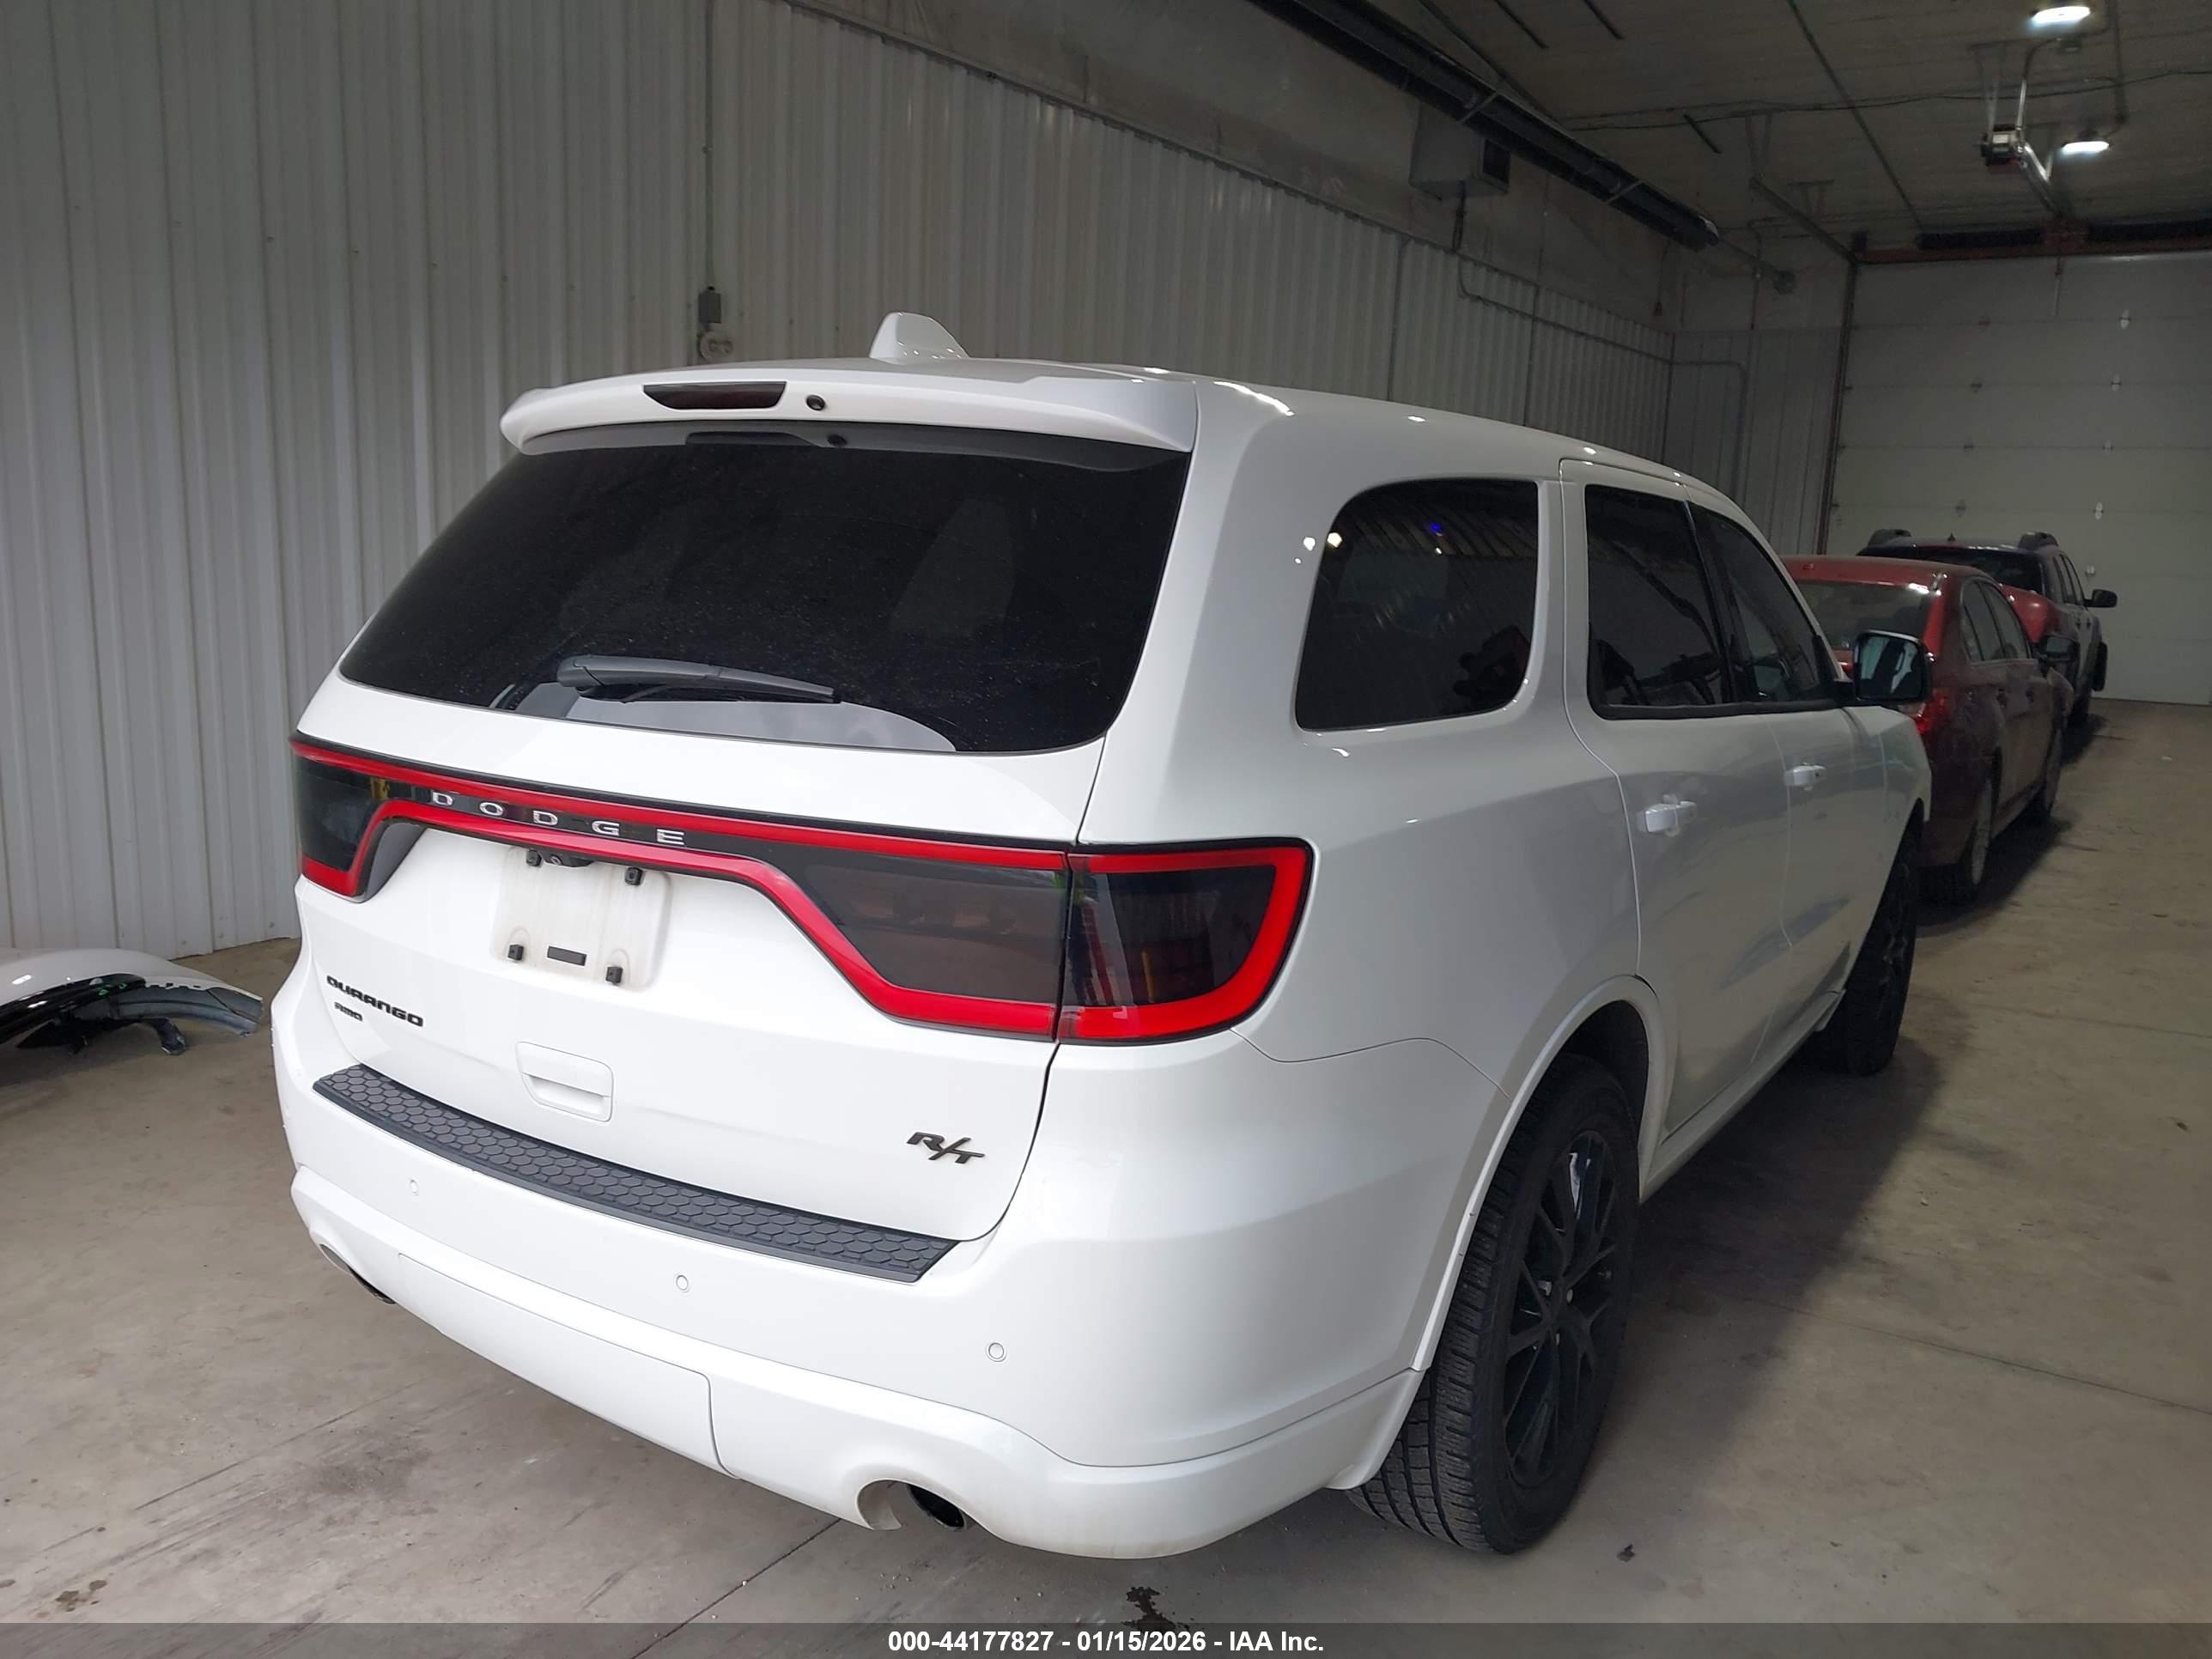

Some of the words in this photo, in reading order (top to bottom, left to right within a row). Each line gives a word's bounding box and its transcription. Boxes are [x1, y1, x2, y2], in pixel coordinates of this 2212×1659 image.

[432, 792, 685, 846] DODGE
[326, 975, 423, 1027] DURANGO
[906, 1131, 986, 1164] R/T
